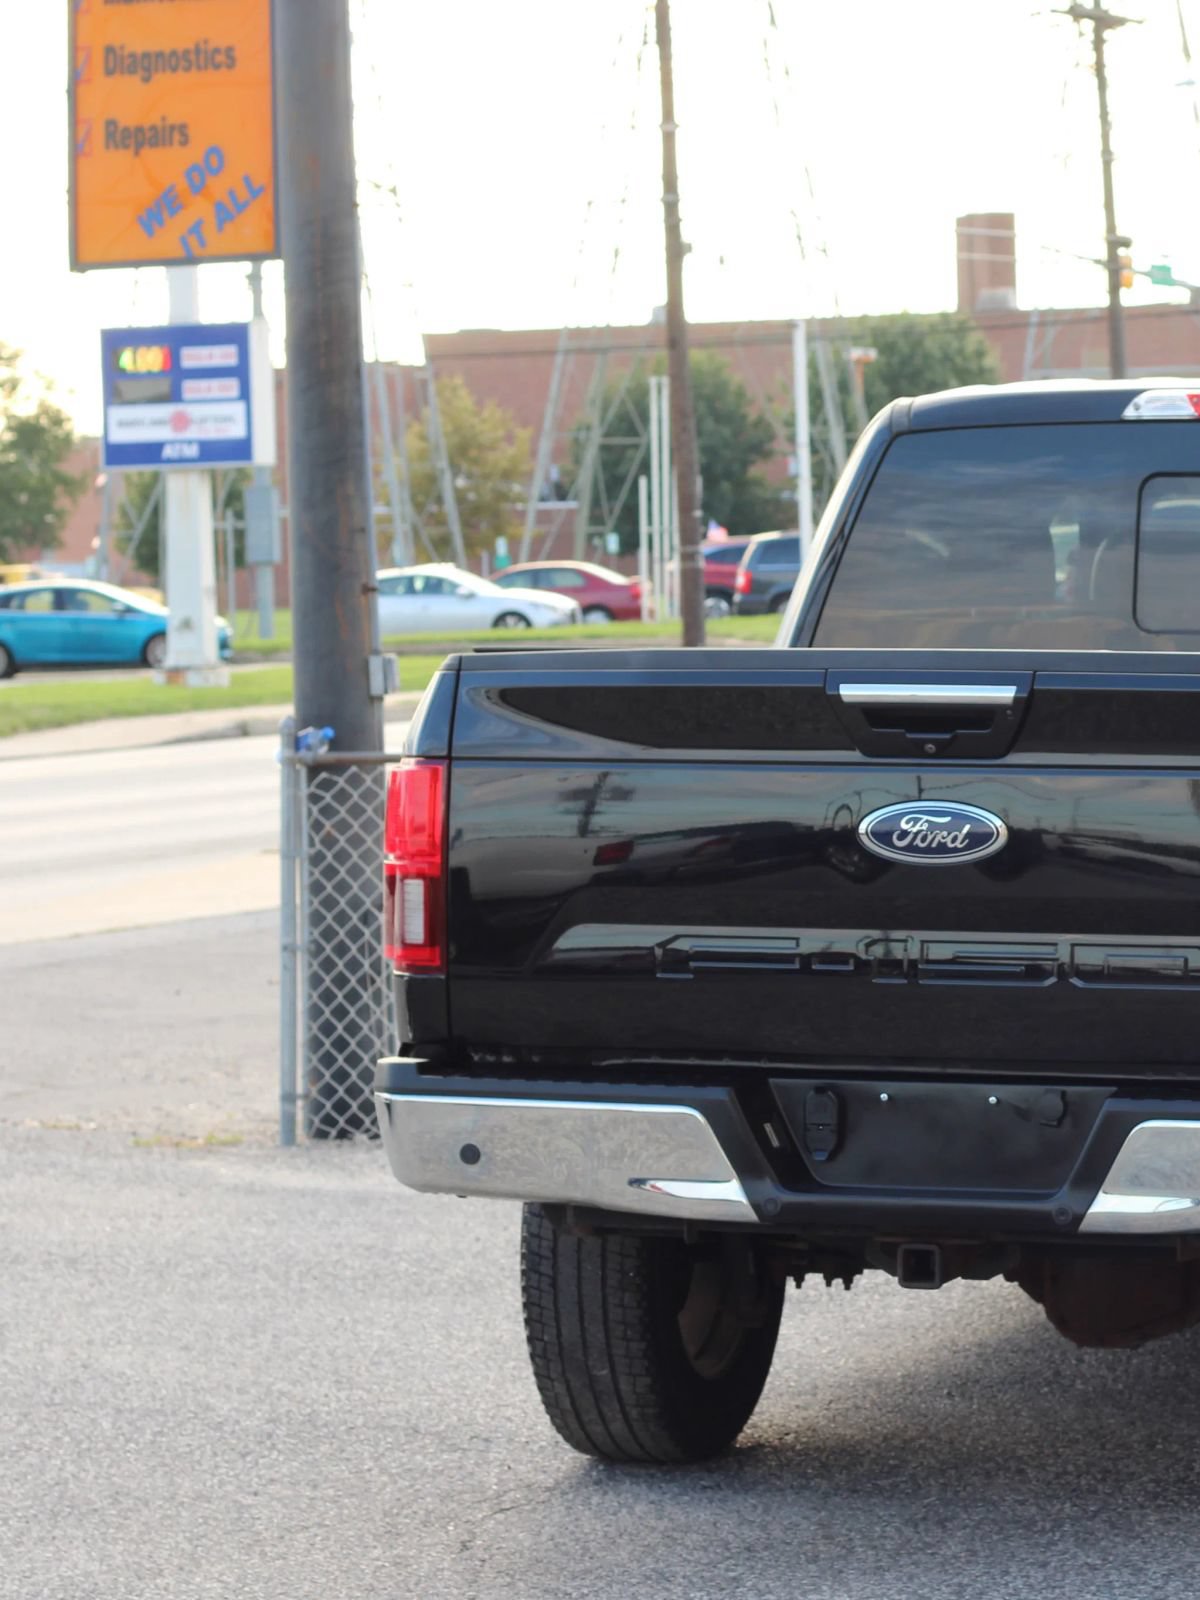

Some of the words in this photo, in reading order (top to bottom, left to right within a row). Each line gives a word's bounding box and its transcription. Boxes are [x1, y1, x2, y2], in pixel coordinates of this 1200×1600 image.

[103, 39, 237, 83] Diagnostics
[105, 116, 190, 157] Repairs
[136, 184, 184, 239] WE
[184, 146, 224, 196] DO
[178, 218, 207, 259] IT
[211, 173, 266, 233] ALL
[892, 813, 972, 849] Ford
